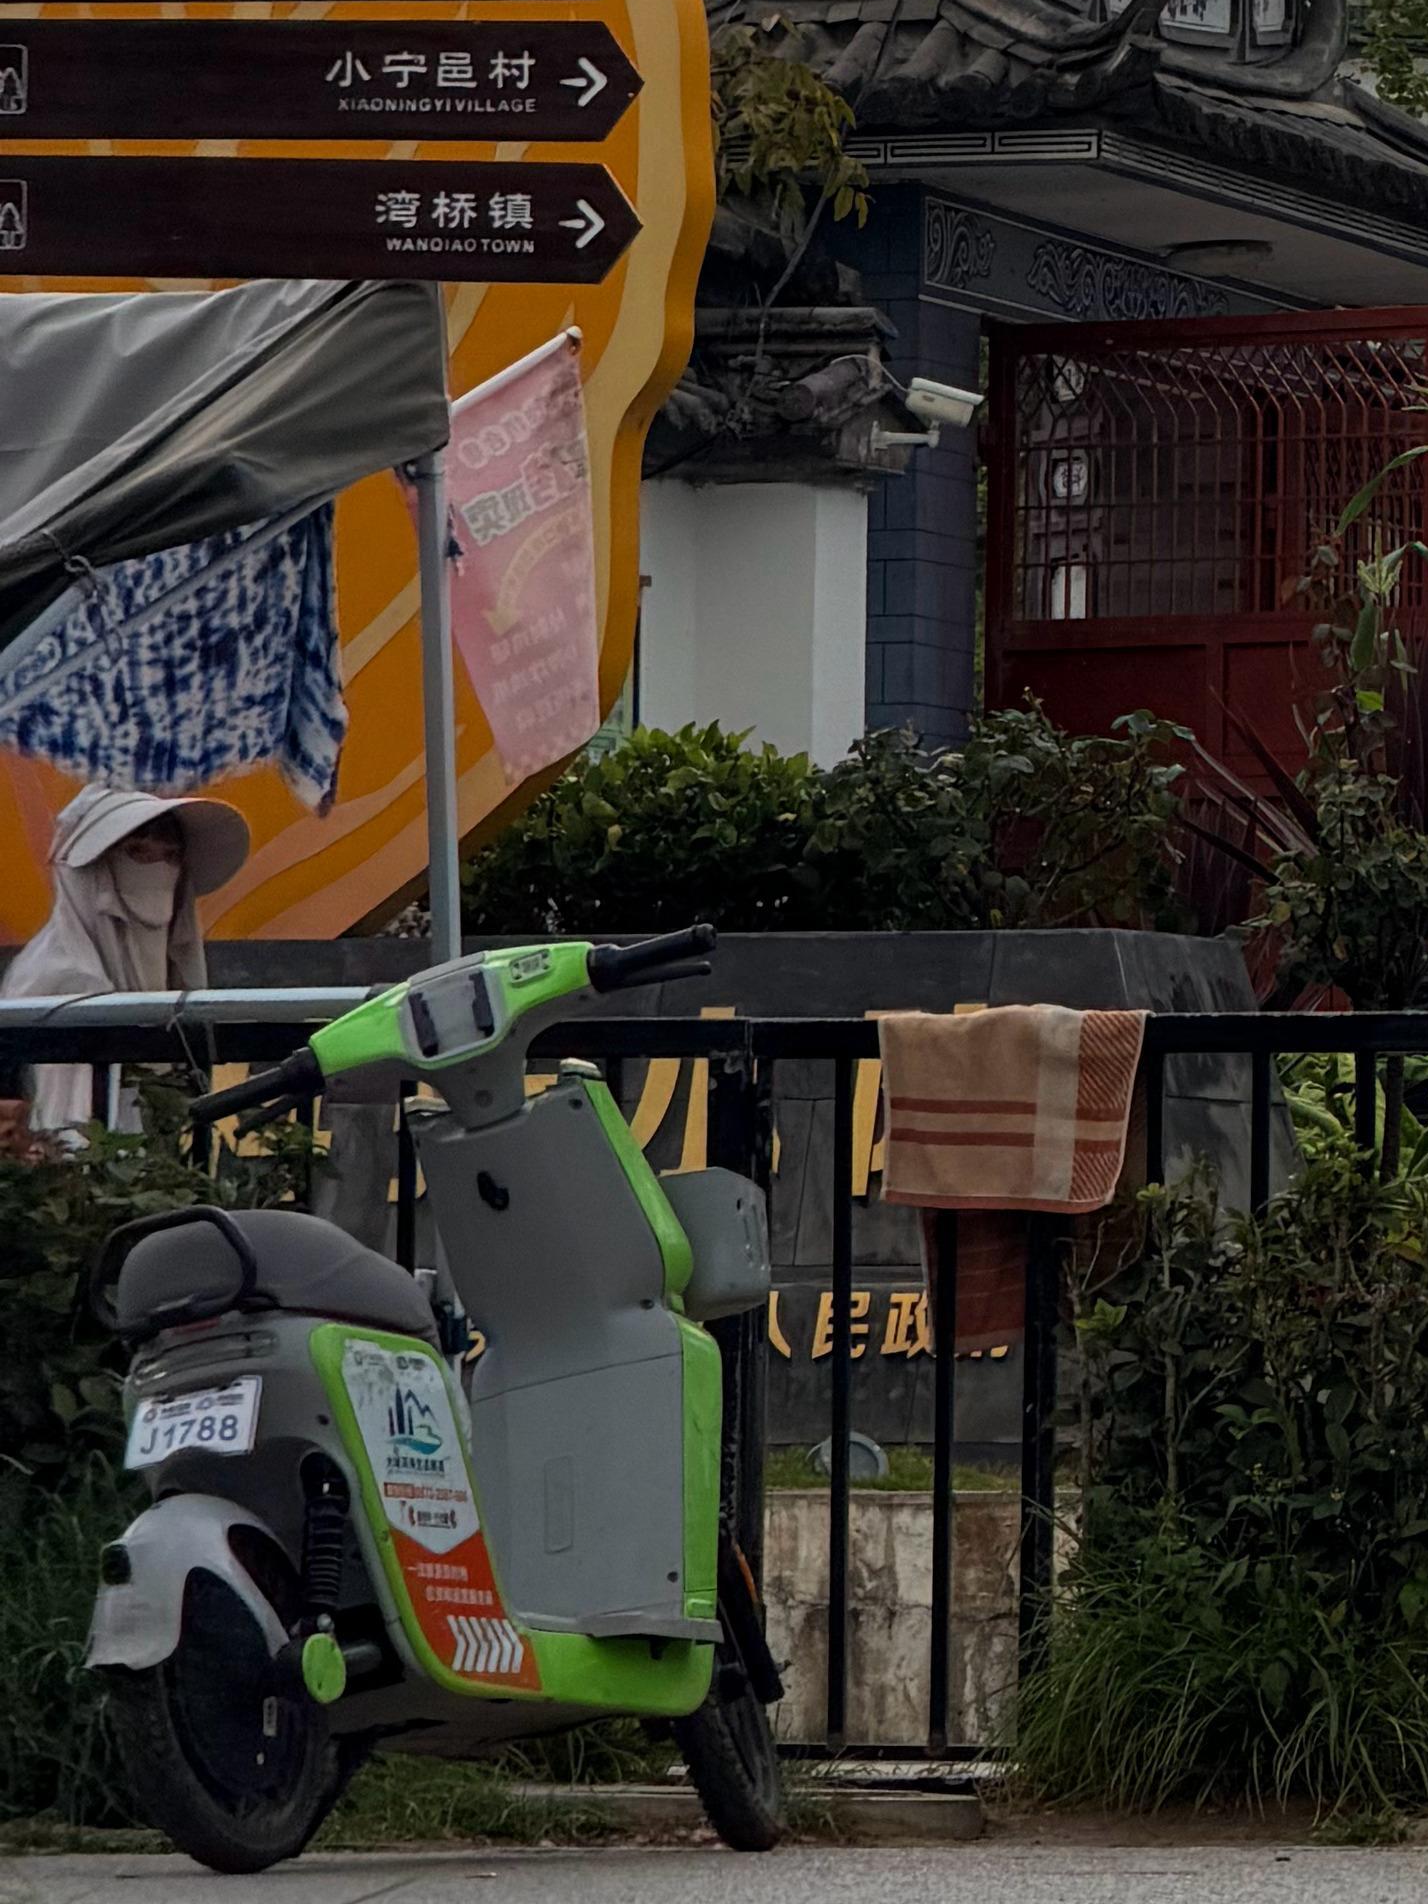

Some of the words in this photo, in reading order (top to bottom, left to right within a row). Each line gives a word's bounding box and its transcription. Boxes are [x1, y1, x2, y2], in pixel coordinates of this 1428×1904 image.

[325, 50, 536, 90] 小宁邑村
[338, 97, 452, 112] XIAONINGYI
[454, 97, 536, 113] VILLAGE
[374, 189, 534, 230] 湾桥镇
[480, 238, 535, 254] TOWN
[140, 1414, 239, 1455] J1788
